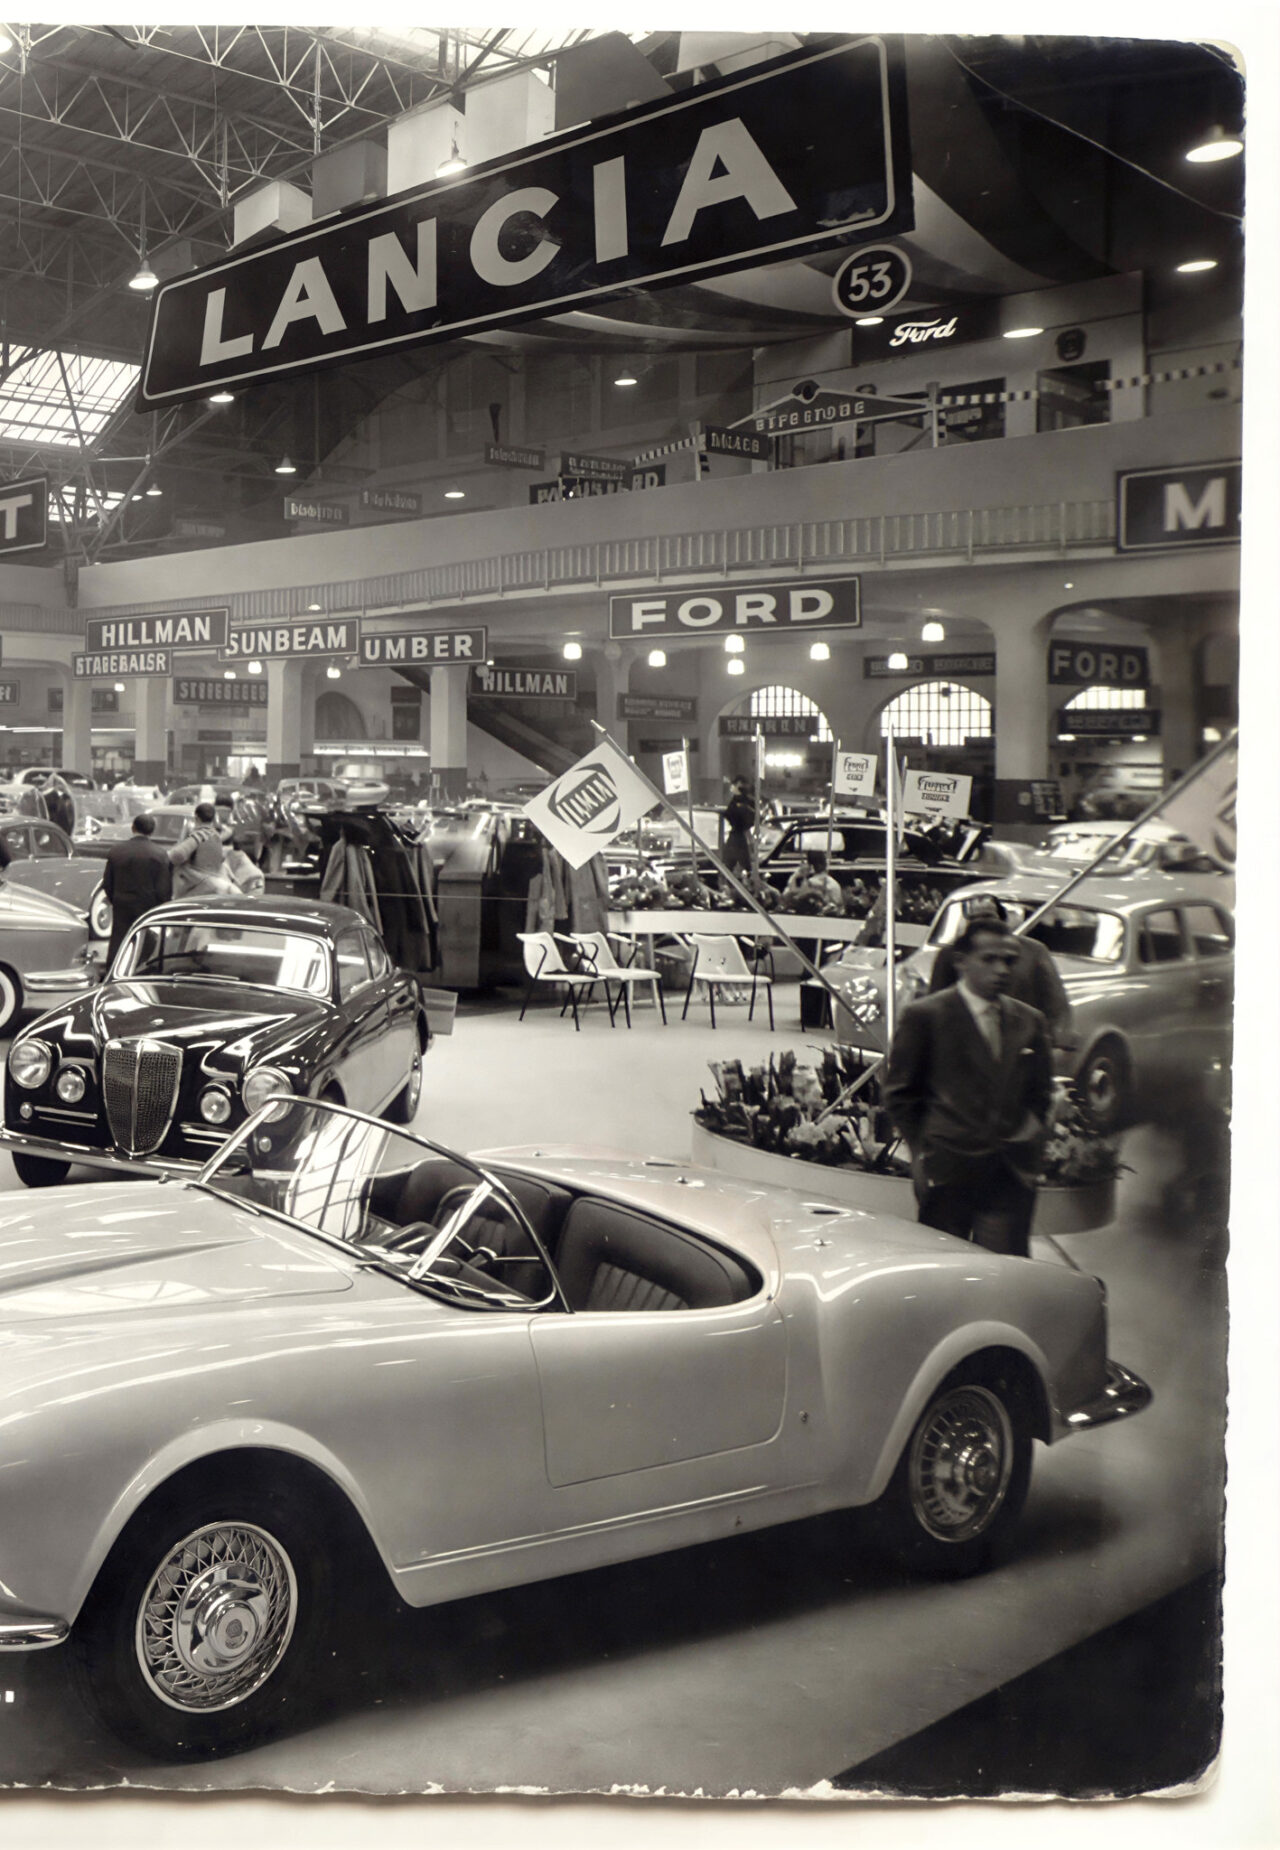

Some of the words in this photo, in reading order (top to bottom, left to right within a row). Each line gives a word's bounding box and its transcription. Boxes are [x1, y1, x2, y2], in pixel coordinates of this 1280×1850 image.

[199, 117, 799, 367] LANCIA
[848, 261, 892, 302] 53
[889, 317, 958, 347] Ford
[631, 589, 834, 631] FORD
[101, 616, 211, 647] HILLMAN
[226, 624, 347, 656] SUNBEAM
[1053, 650, 1140, 680] FORD
